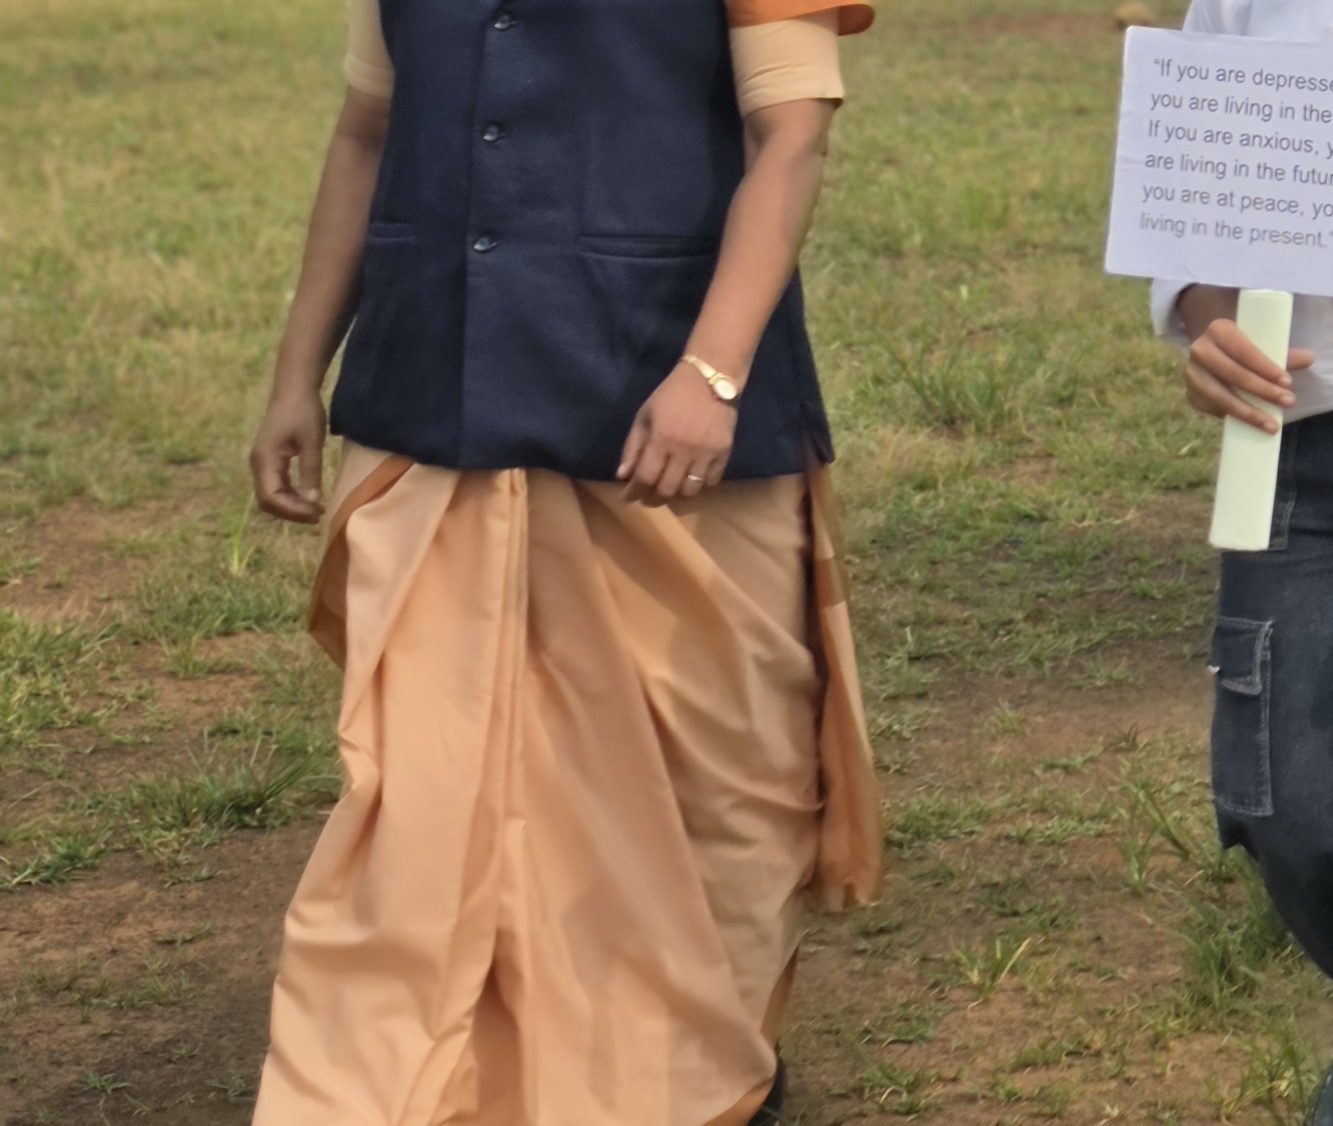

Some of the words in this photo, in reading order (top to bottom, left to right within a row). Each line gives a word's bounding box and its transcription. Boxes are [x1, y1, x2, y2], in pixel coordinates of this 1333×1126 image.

[1177, 64, 1209, 84] you
[1216, 67, 1246, 84] are
[1150, 92, 1182, 111] you
[1188, 96, 1219, 113] are
[1225, 95, 1272, 122] living
[1279, 101, 1296, 119] in
[1303, 106, 1331, 124] the
[1149, 120, 1159, 138] If
[1165, 124, 1196, 143] you
[1204, 127, 1233, 145] are
[1239, 132, 1319, 157] anxious,
[1145, 153, 1174, 170] are
[1180, 154, 1227, 179] living
[1234, 159, 1249, 176] in
[1257, 161, 1285, 182] the
[1142, 184, 1175, 203] you
[1181, 188, 1210, 205] are
[1217, 192, 1234, 208] at
[1140, 212, 1185, 238] living
[1192, 215, 1208, 235] in
[1215, 220, 1243, 240] the
